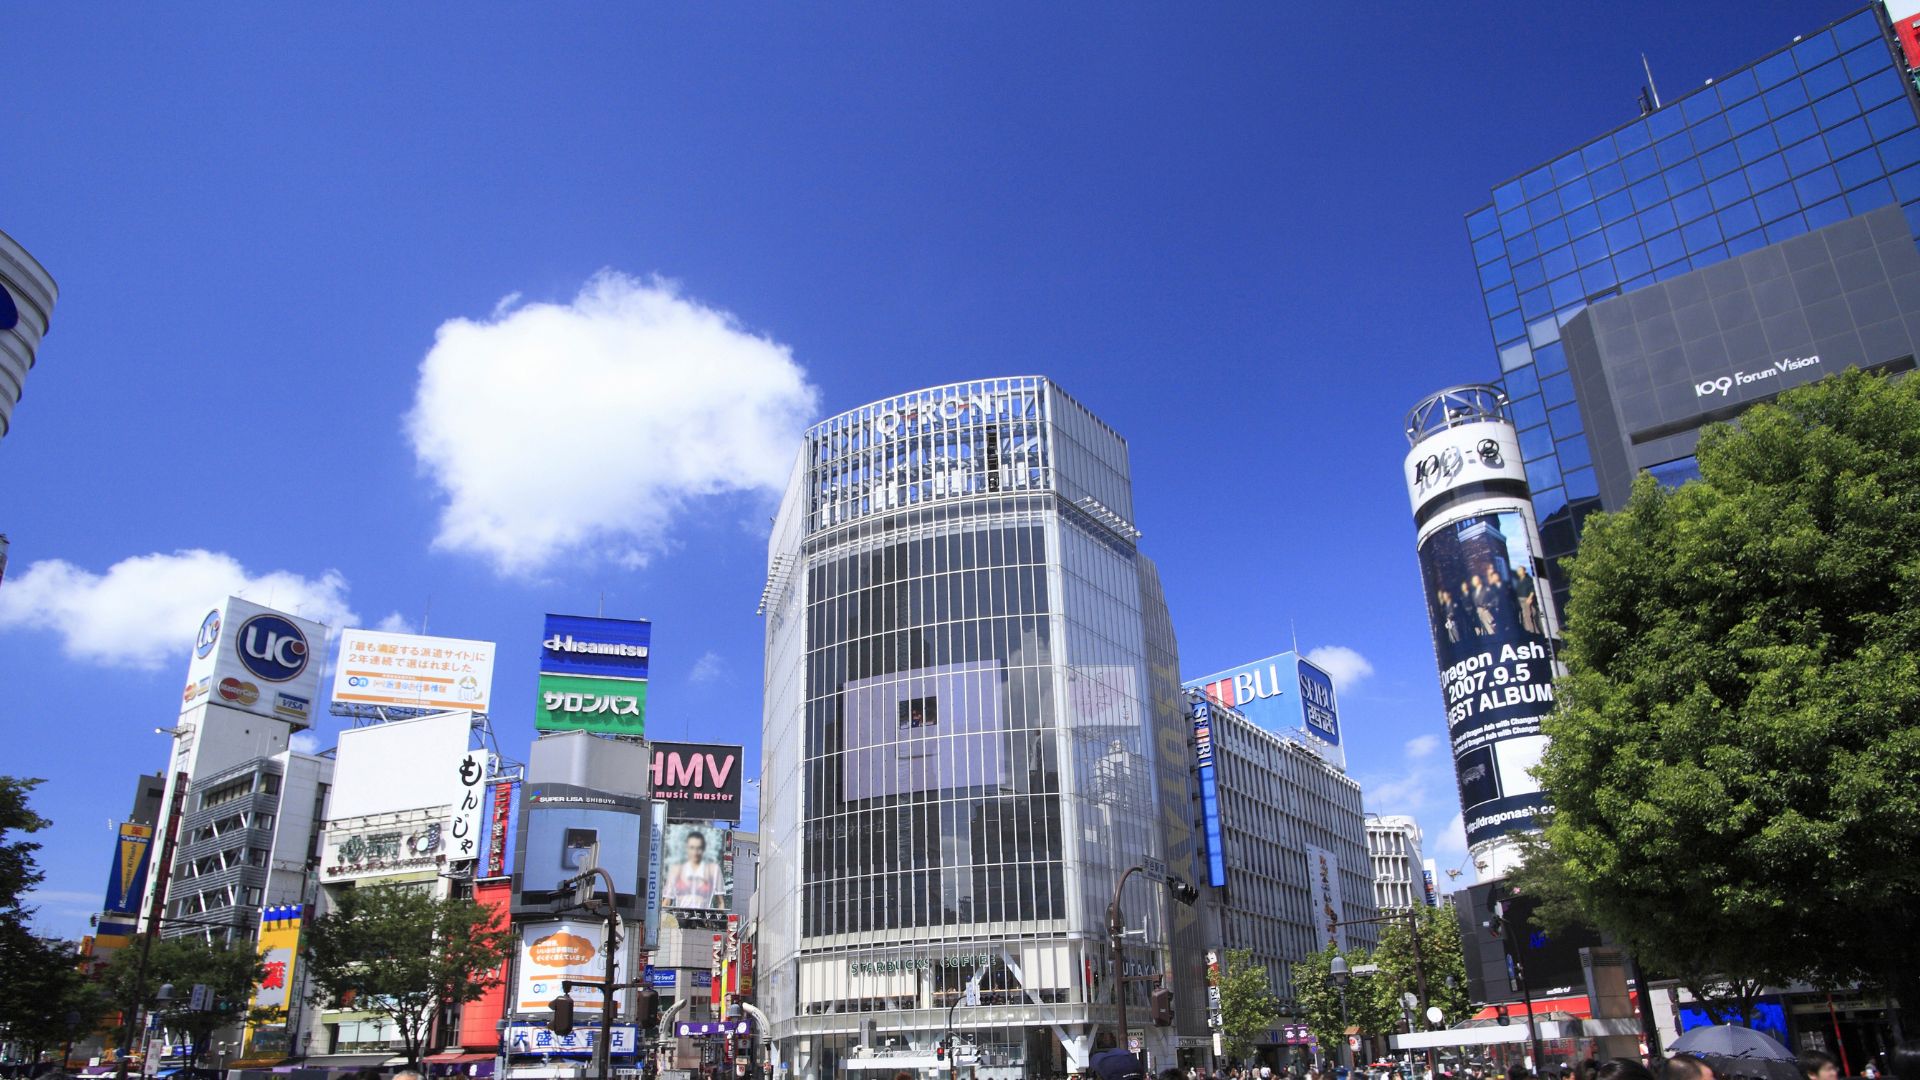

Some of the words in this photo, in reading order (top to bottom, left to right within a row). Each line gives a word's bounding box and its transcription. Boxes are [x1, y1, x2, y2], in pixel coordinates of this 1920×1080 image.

[1695, 376, 1732, 397] 109
[1735, 367, 1777, 386] Forum
[1774, 355, 1820, 373] Vision
[245, 626, 306, 668] UC
[544, 634, 648, 658] Hisamitsu
[1441, 652, 1493, 688] Dragon
[1500, 641, 1545, 663] Ash
[1214, 664, 1283, 708] IBU
[1299, 673, 1335, 712] SEIBU
[1448, 663, 1531, 704] 2007.9.5
[1479, 683, 1554, 712] ALBUM
[282, 699, 303, 711] VISA
[543, 690, 640, 716] サロンパス
[1307, 702, 1336, 735] 西武
[1194, 706, 1213, 767] SEIBU
[1484, 722, 1495, 732] Ash
[1496, 719, 1510, 729] with
[1511, 715, 1539, 725] Changes
[1486, 731, 1497, 741] Ash
[1497, 728, 1512, 738] with
[649, 751, 735, 789] HMV
[453, 755, 482, 854] もんじゃ
[586, 797, 616, 805] SHIBUYA
[656, 790, 688, 800] music
[694, 790, 734, 801] master
[647, 871, 656, 910] neon
[851, 959, 932, 975] STARBUCKS
[1108, 961, 1160, 976] TUTAYA
